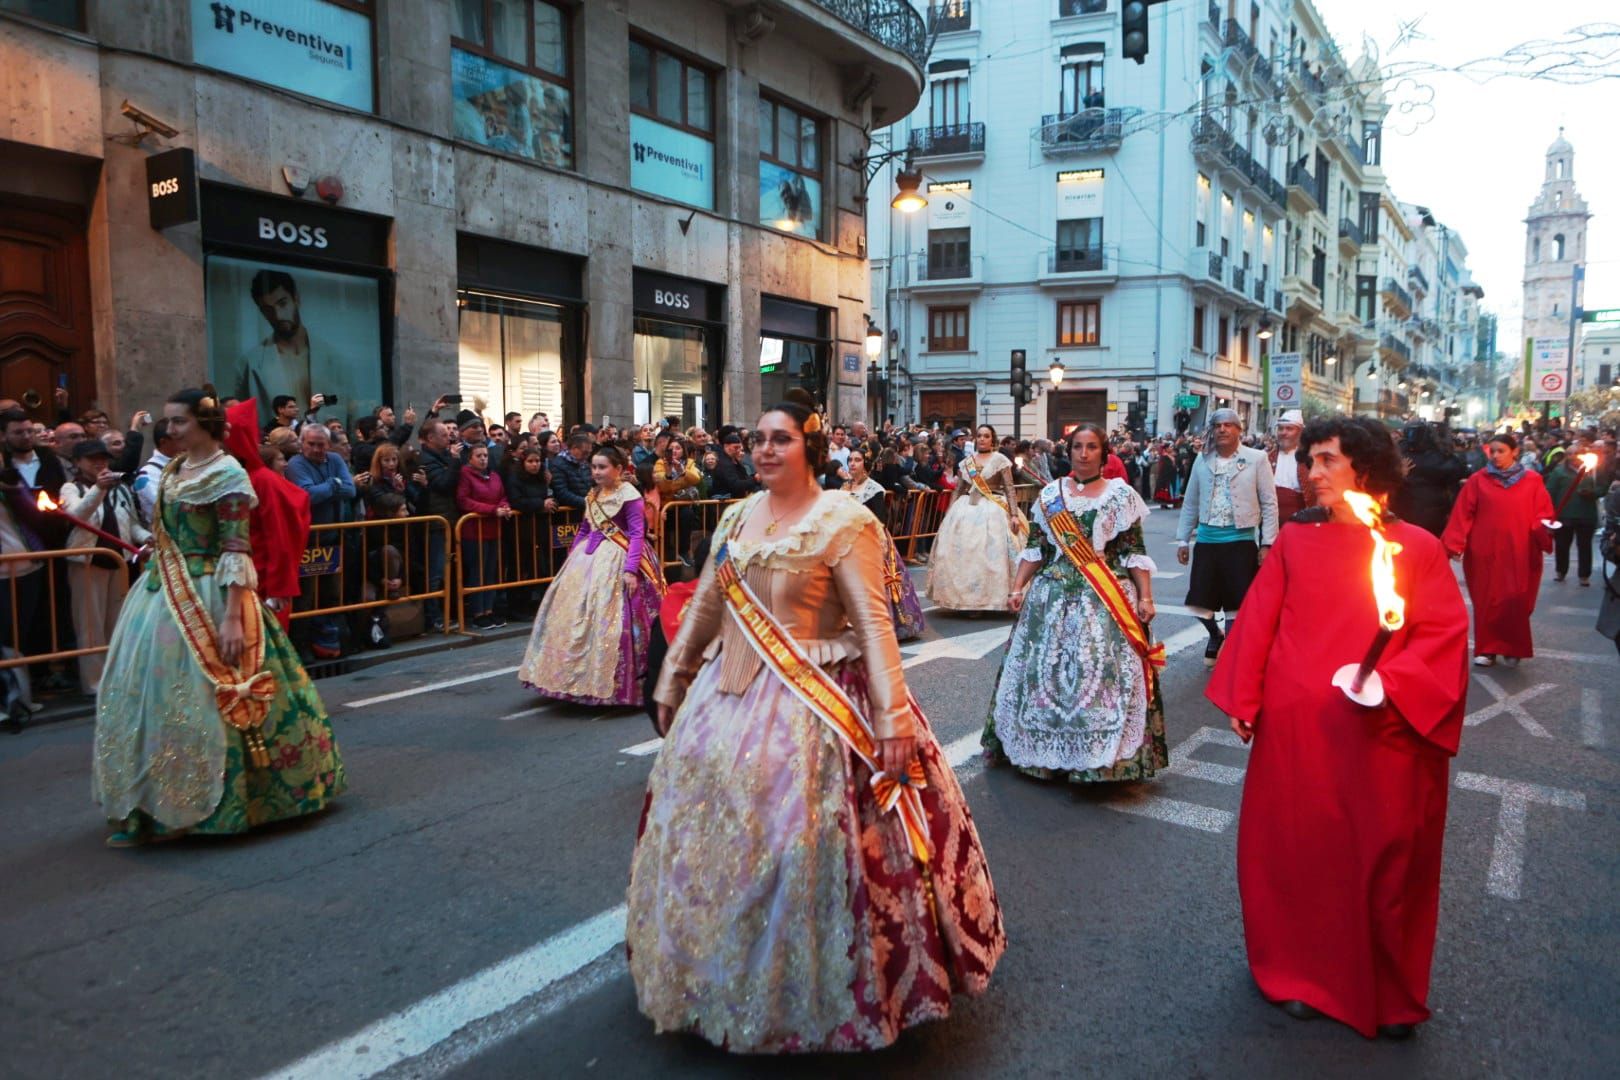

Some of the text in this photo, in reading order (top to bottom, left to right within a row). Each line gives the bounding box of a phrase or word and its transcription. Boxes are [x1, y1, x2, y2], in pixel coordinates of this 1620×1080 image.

[240, 10, 344, 58] Preventiva
[308, 50, 344, 69] Seguros
[647, 146, 698, 173] Preventiva
[152, 178, 179, 198] BOSS
[258, 217, 328, 249] BOSS
[655, 289, 690, 309] BOSS
[556, 524, 579, 537] SPV
[301, 547, 334, 564] SPV
